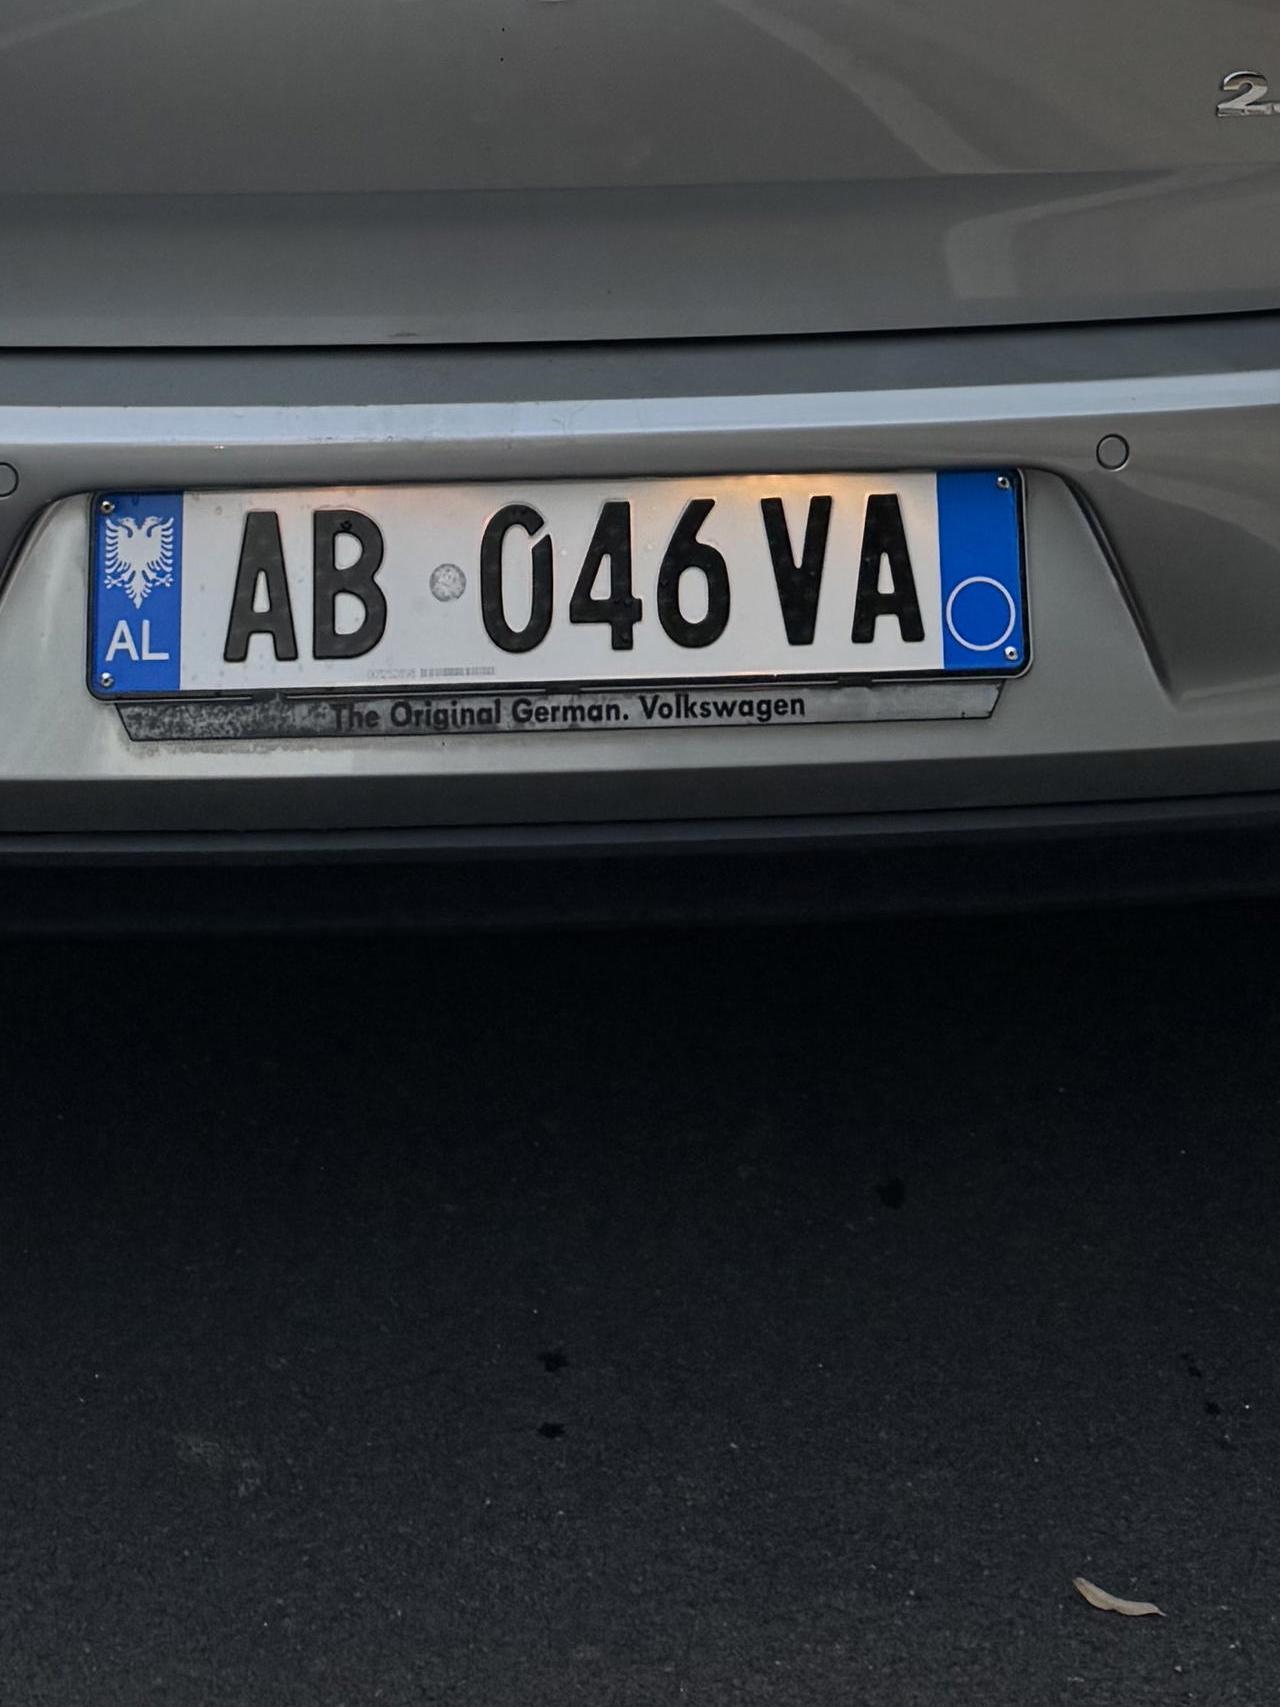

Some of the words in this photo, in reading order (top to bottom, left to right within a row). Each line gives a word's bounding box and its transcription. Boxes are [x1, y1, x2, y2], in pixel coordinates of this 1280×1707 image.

[223, 509, 388, 663] AB
[480, 498, 732, 654] 046
[761, 493, 925, 645] VA
[105, 619, 169, 662] AL
[330, 701, 380, 731] The
[391, 698, 501, 731] Original
[512, 694, 629, 724] German.
[638, 692, 806, 723] Volkswagen
